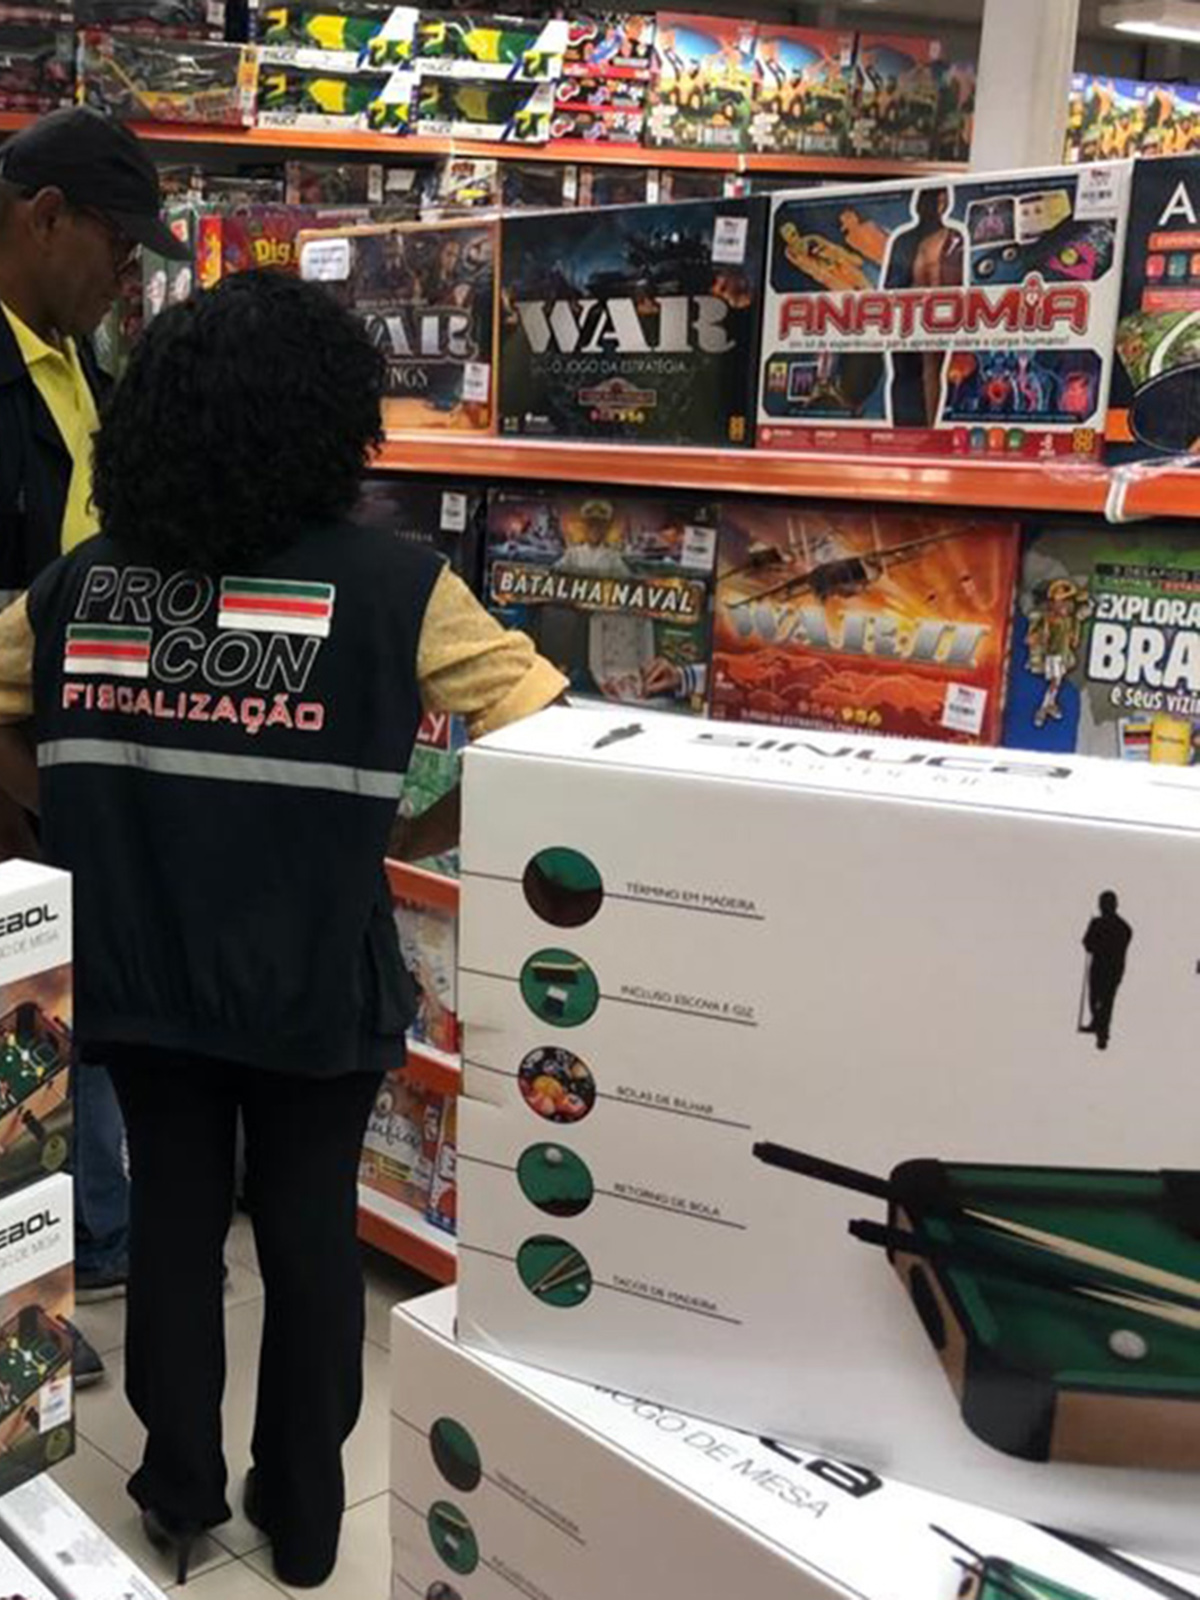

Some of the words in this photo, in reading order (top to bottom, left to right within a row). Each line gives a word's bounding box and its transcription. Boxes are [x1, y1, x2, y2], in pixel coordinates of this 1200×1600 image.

[1158, 181, 1197, 226] A
[515, 295, 736, 354] WAR
[778, 272, 1090, 340] ANATOMIA
[365, 312, 478, 357] AR
[74, 565, 214, 626] PRO
[499, 572, 602, 602] BATALHA
[615, 582, 693, 614] NAVAL
[725, 603, 904, 656] WAR
[151, 626, 321, 692] CON
[62, 682, 325, 734] FISCALIZAÇÃO
[1124, 688, 1163, 711] seus
[683, 1430, 740, 1463] DE
[731, 1458, 831, 1519] MESA
